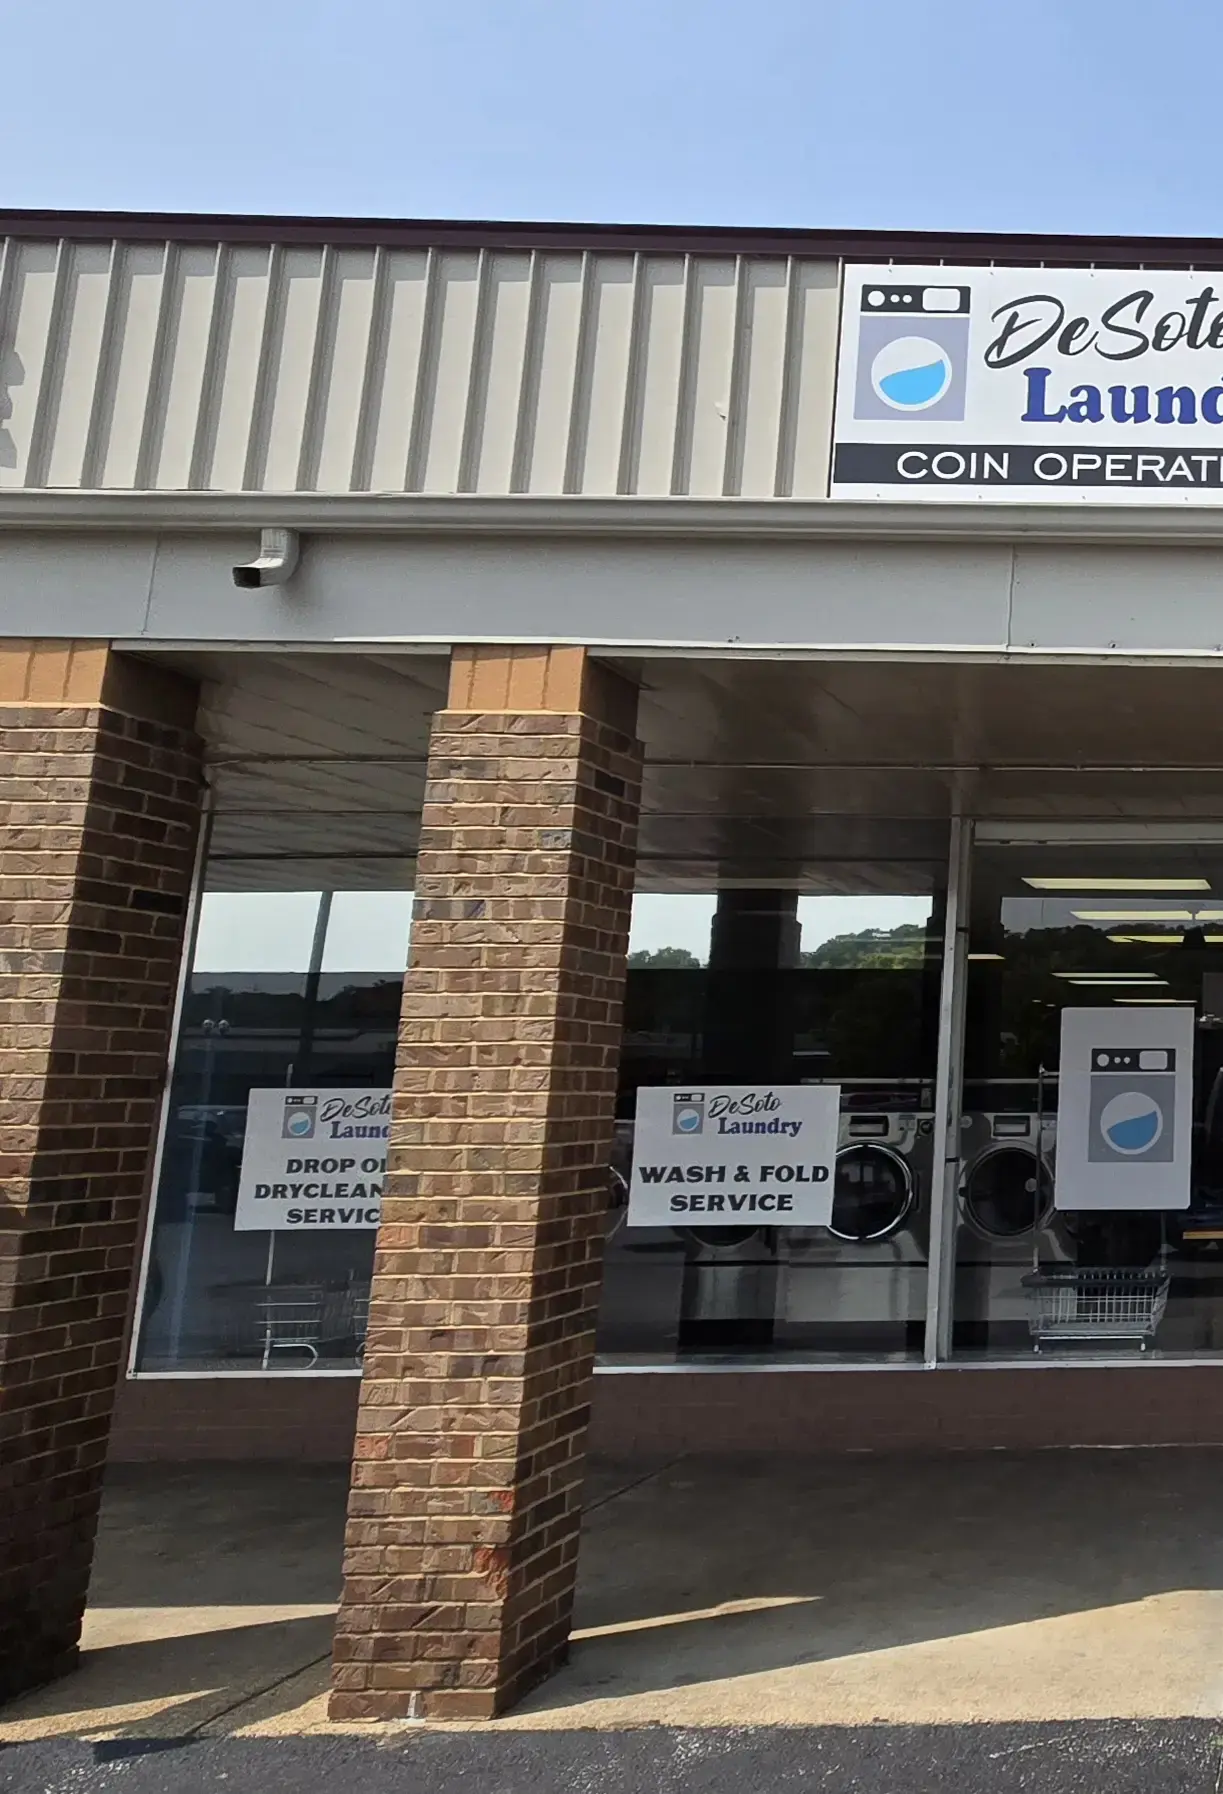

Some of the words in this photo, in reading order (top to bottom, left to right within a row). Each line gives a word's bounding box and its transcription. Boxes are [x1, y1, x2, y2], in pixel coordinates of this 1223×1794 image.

[897, 451, 1009, 480] COIN
[708, 1091, 782, 1119] DeSoto
[717, 1117, 803, 1138] Laundry
[286, 1158, 356, 1174] DROP
[638, 1165, 726, 1184] WASH
[733, 1165, 750, 1183] &
[759, 1165, 829, 1183] FOLD
[254, 1183, 383, 1199] DRYCLEAN
[669, 1194, 793, 1212] SERVICE
[286, 1208, 380, 1224] SERVIC
